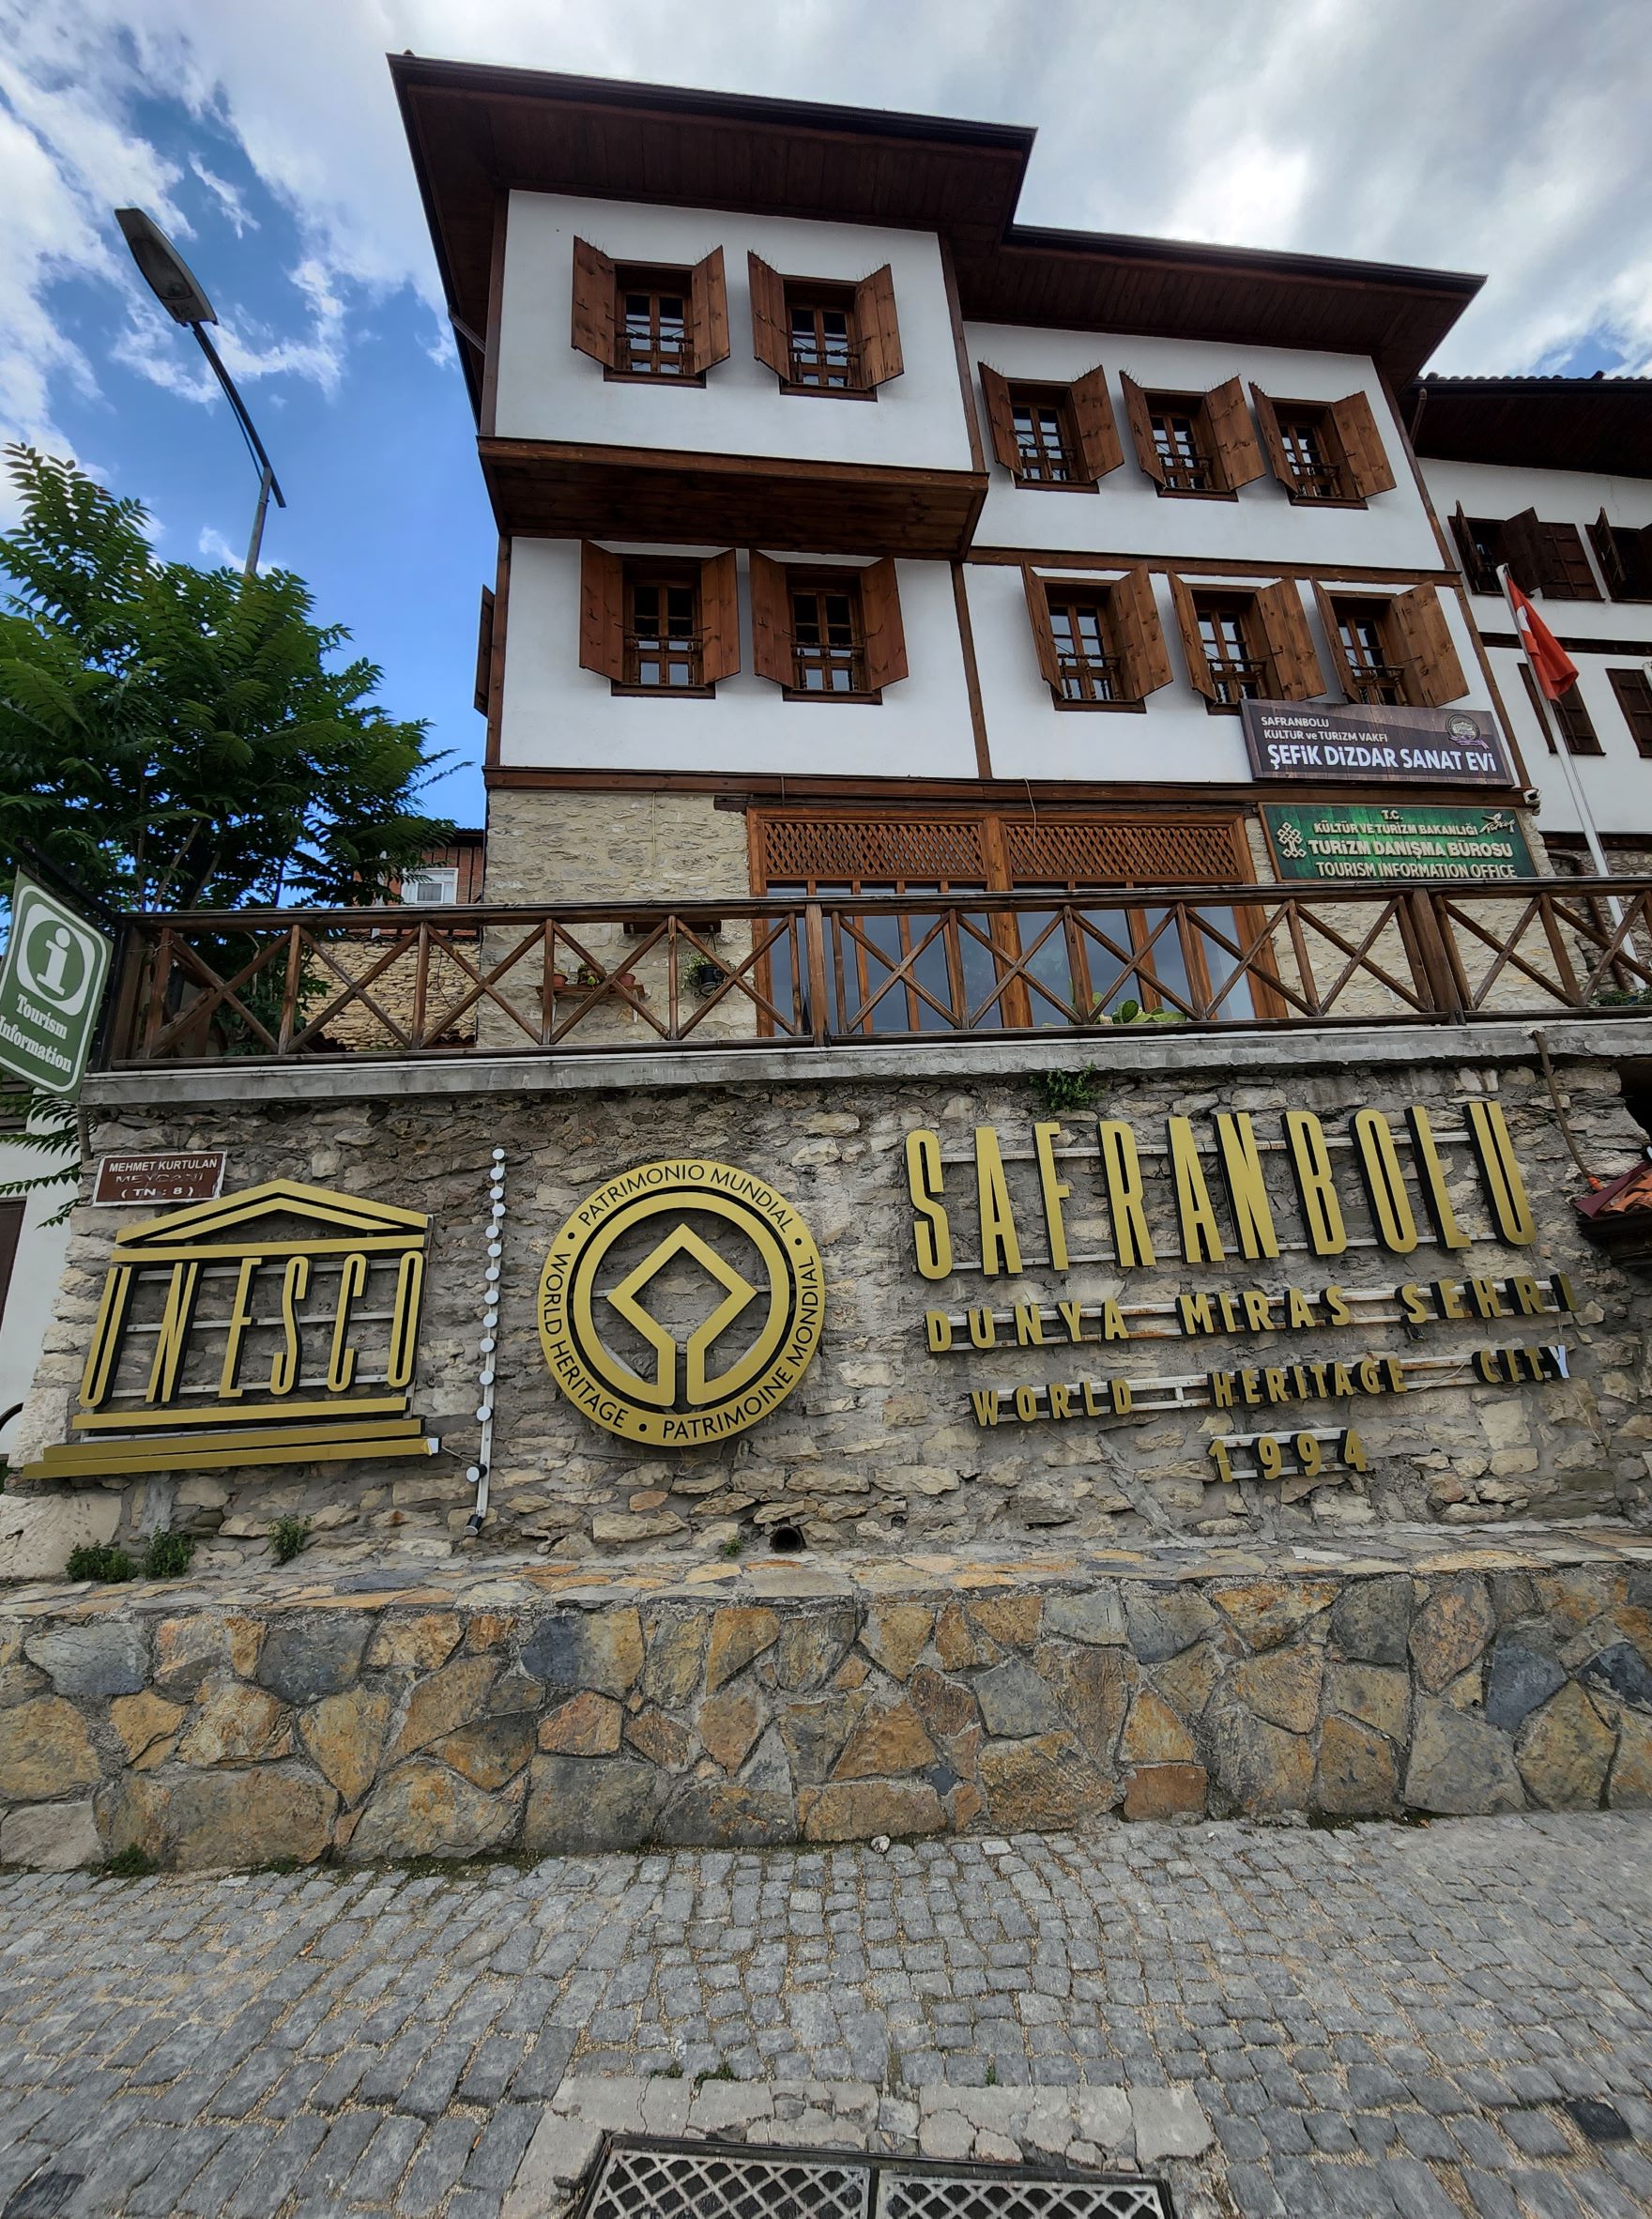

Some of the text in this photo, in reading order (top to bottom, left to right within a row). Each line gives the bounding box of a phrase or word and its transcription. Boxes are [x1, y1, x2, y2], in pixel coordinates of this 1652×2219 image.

[1261, 716, 1330, 727] SAFRANBOLU
[1358, 732, 1388, 742] VAKFI
[1400, 749, 1462, 771] SANAT
[1314, 819, 1478, 835] KÜLTÜR VE TURİZM BAKANLIĞI
[1381, 809, 1404, 820] T.C.
[1315, 861, 1517, 879] TOURISM INFORMATION OFFICE
[1372, 842, 1446, 860] DANIŞMA
[1447, 839, 1514, 857] BÜROSU
[16, 993, 68, 1040] Tourism
[0, 1015, 72, 1073] Information
[109, 1158, 218, 1172] MEHMET KURTULAN
[577, 1164, 794, 1233] PATRIMONIO MUNDIAL
[904, 1101, 1537, 1280] SAFRANBOLU
[79, 1250, 424, 1409] UNESCO
[925, 1273, 1578, 1353] DUNYA MIRAS SEHRI
[543, 1252, 630, 1429] WORLD HERITAGE
[662, 1255, 819, 1440] PATRIMOINE MONDIAL
[971, 1344, 1569, 1427] WORLD HERITAGE CITY
[1207, 1429, 1369, 1482] 1994
